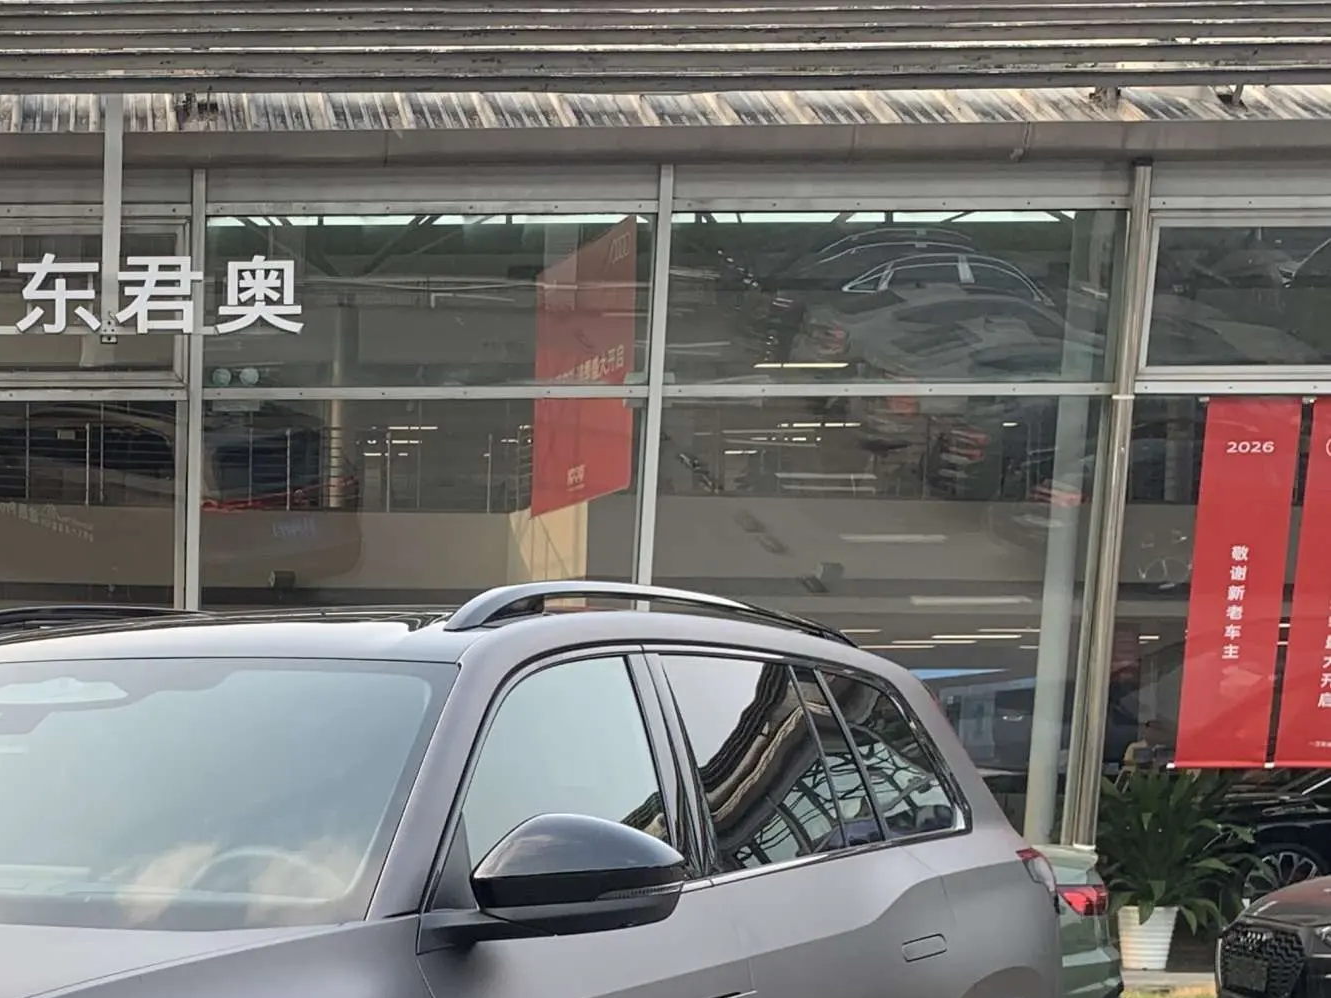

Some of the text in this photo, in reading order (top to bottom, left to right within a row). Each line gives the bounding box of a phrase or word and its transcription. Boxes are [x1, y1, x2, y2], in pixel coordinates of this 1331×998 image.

[1226, 441, 1275, 453] 2026
[1222, 545, 1249, 660] 敬谢新老车主
